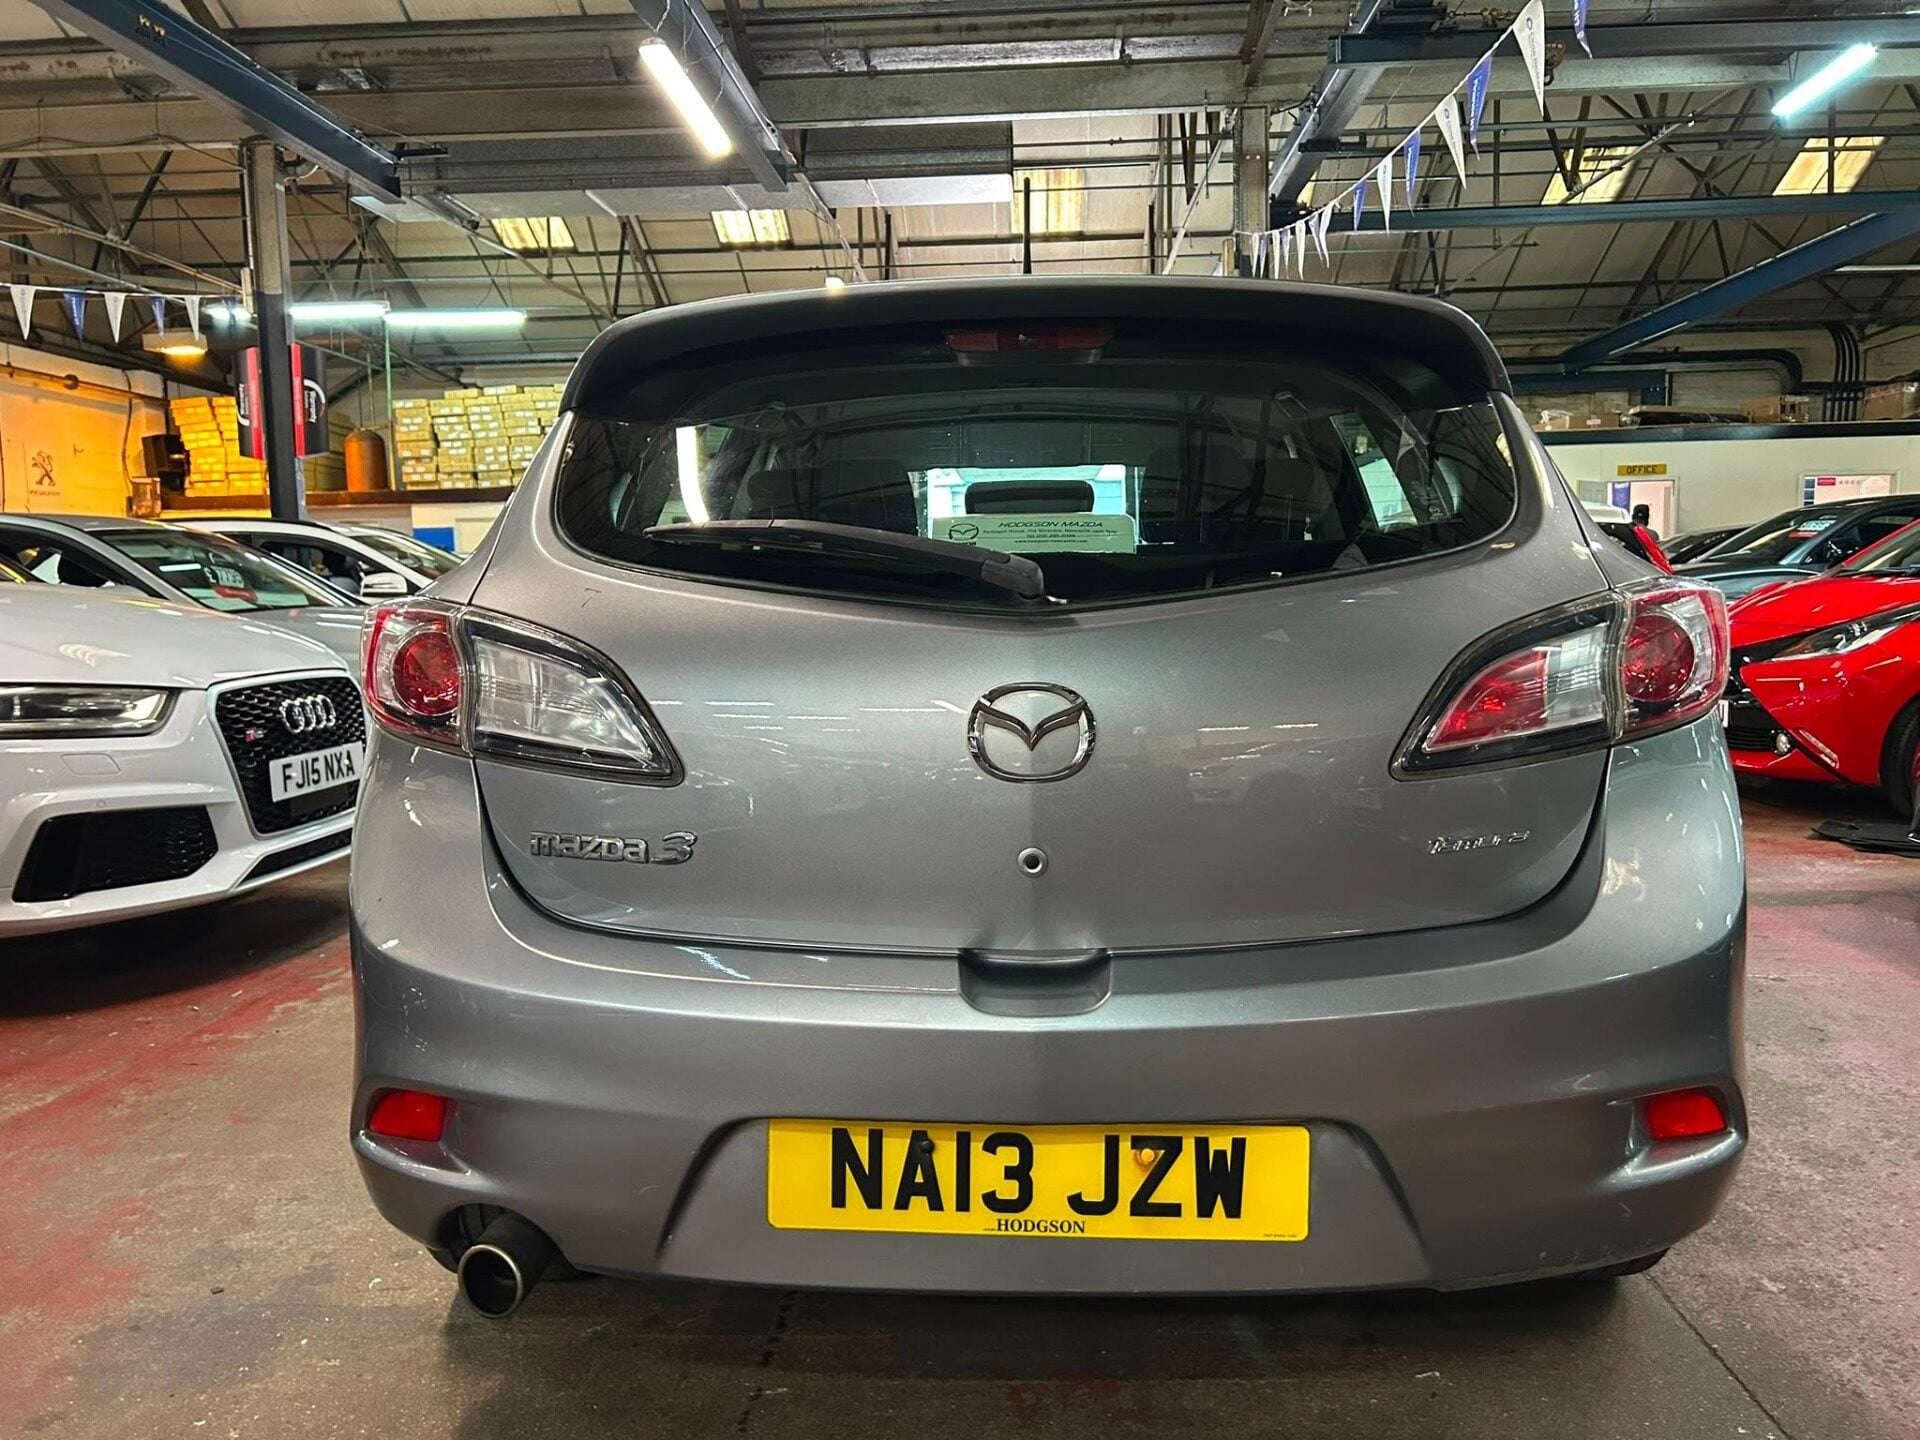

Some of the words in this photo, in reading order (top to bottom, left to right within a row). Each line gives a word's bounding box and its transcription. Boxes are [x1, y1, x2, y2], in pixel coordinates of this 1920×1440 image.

[1626, 465, 1657, 474] OFFICE
[1061, 520, 1103, 528] MAZDA
[281, 756, 321, 793] FJ15
[324, 749, 355, 782] NXA
[530, 830, 649, 864] mazda
[651, 830, 698, 865] 3
[831, 1127, 1034, 1214] NA13
[1066, 1133, 1247, 1220] JZW
[996, 1218, 1086, 1233] HODGSON
